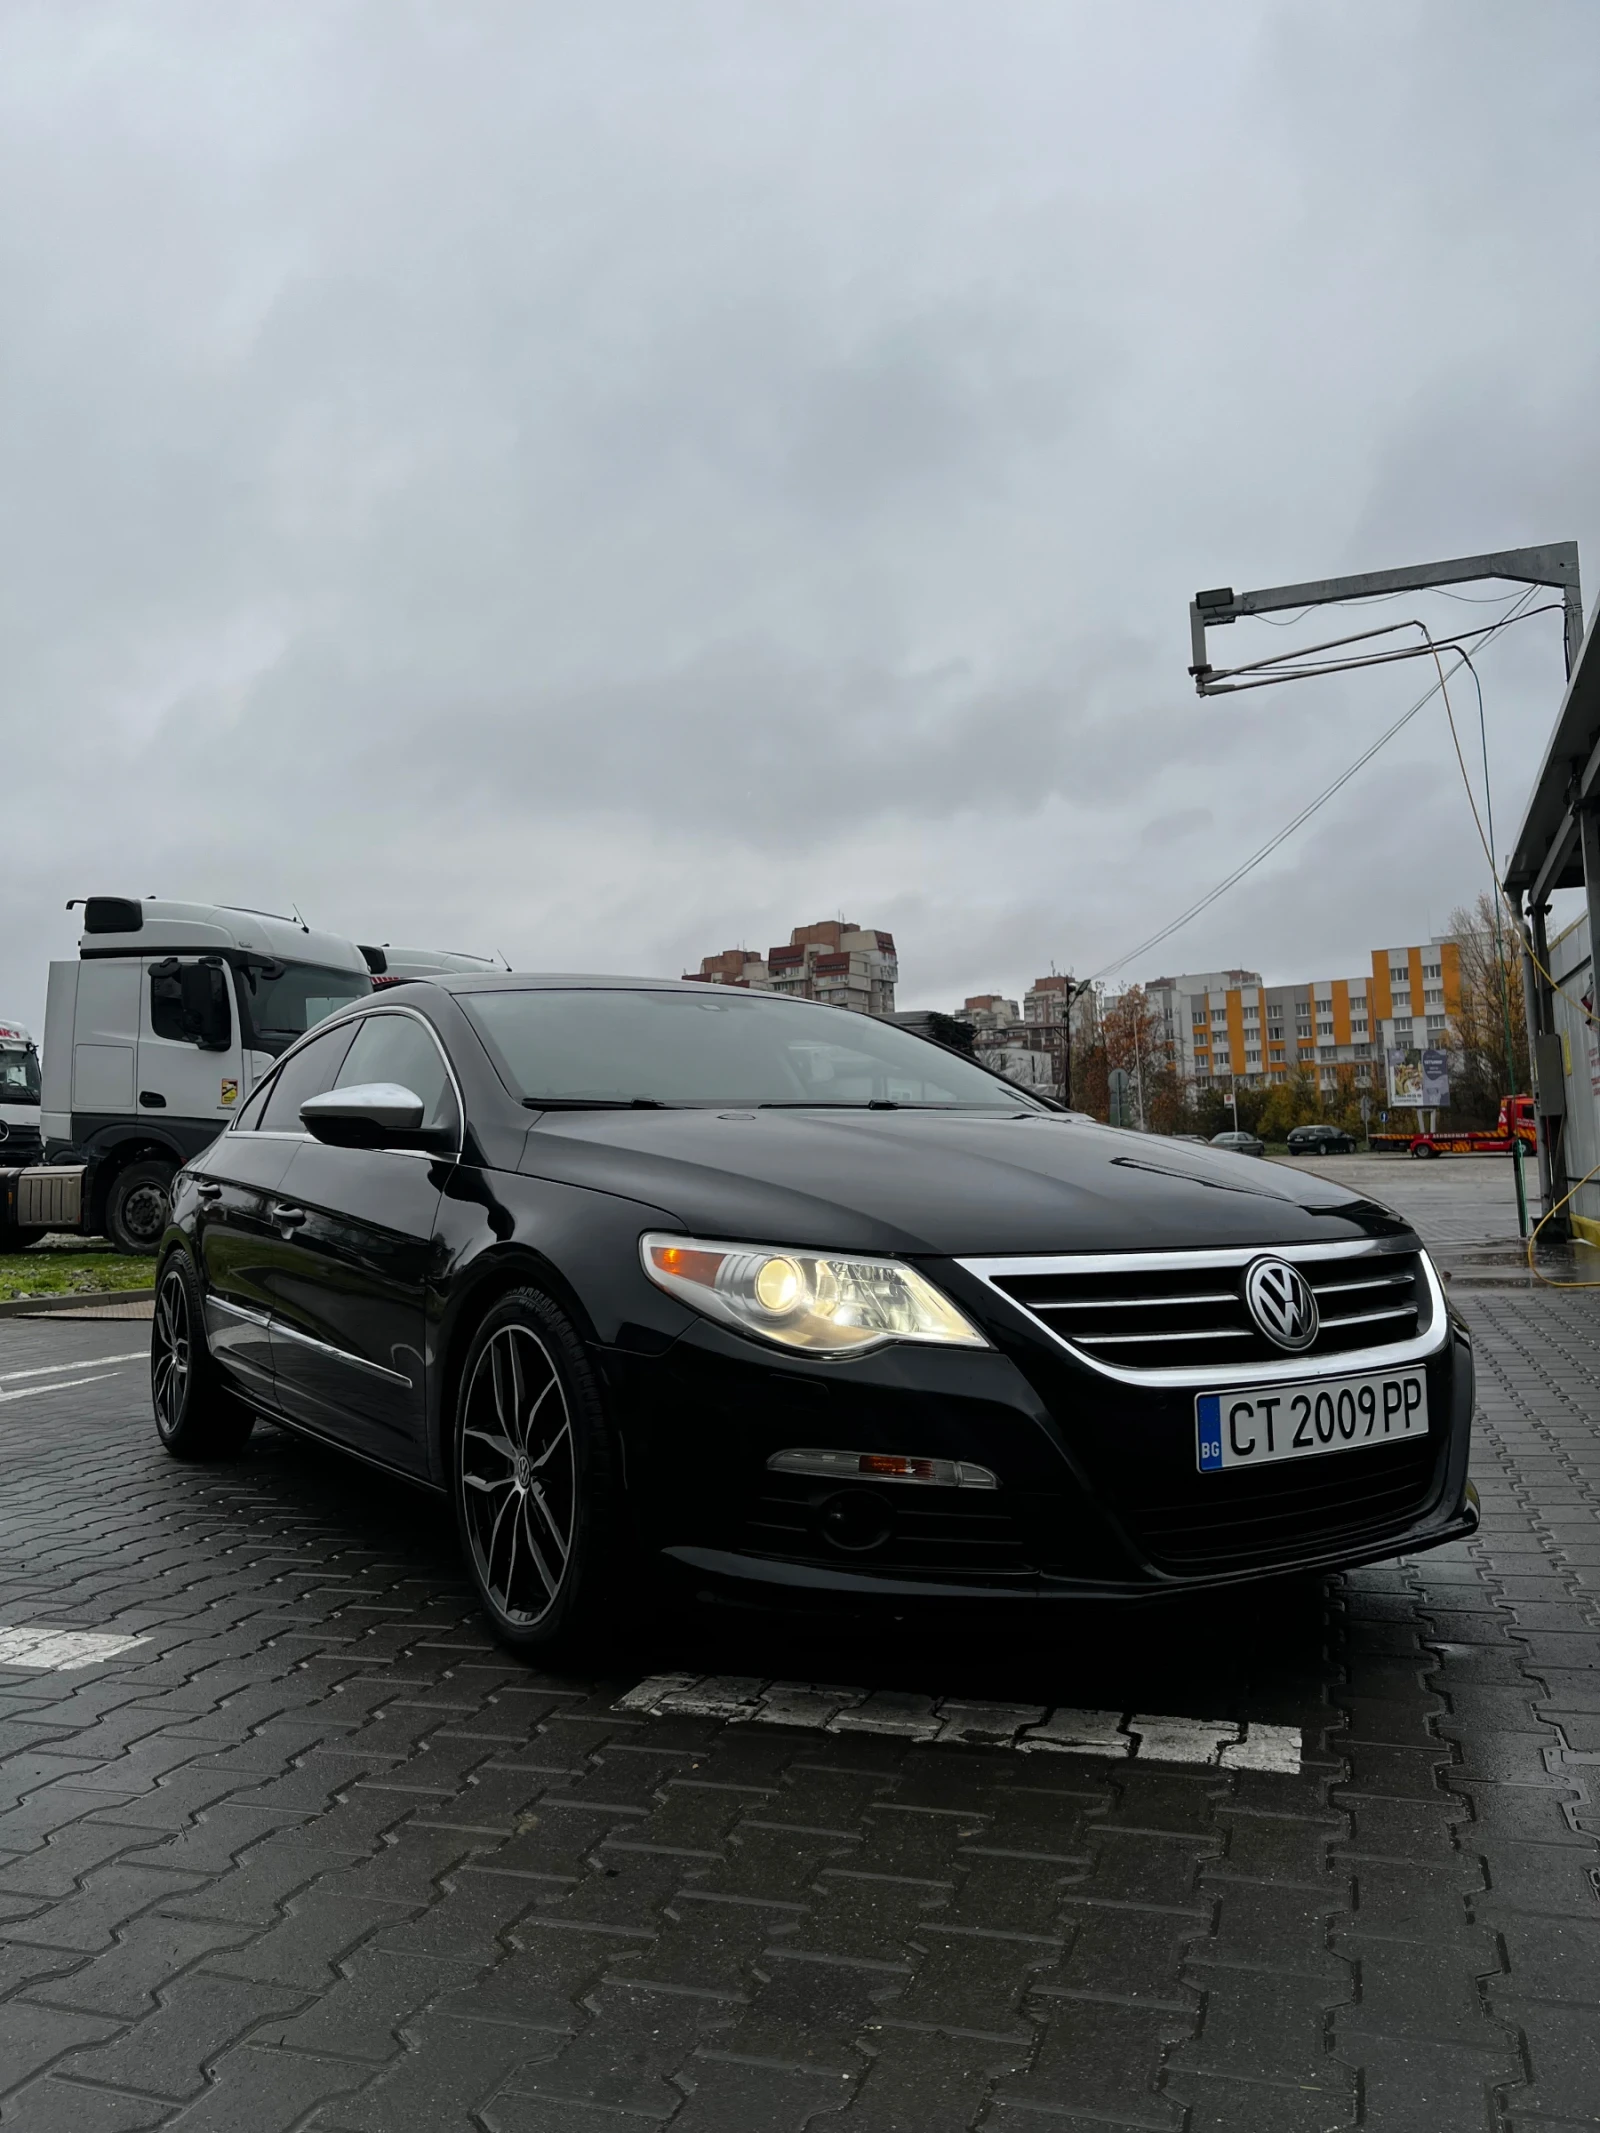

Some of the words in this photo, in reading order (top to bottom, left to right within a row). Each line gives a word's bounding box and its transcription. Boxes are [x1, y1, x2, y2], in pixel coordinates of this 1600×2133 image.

[1250, 1260, 1316, 1343] VW
[1201, 1441, 1220, 1459] BG
[1229, 1397, 1281, 1457] CT
[1290, 1386, 1376, 1449] 2009
[1382, 1377, 1422, 1434] PP
